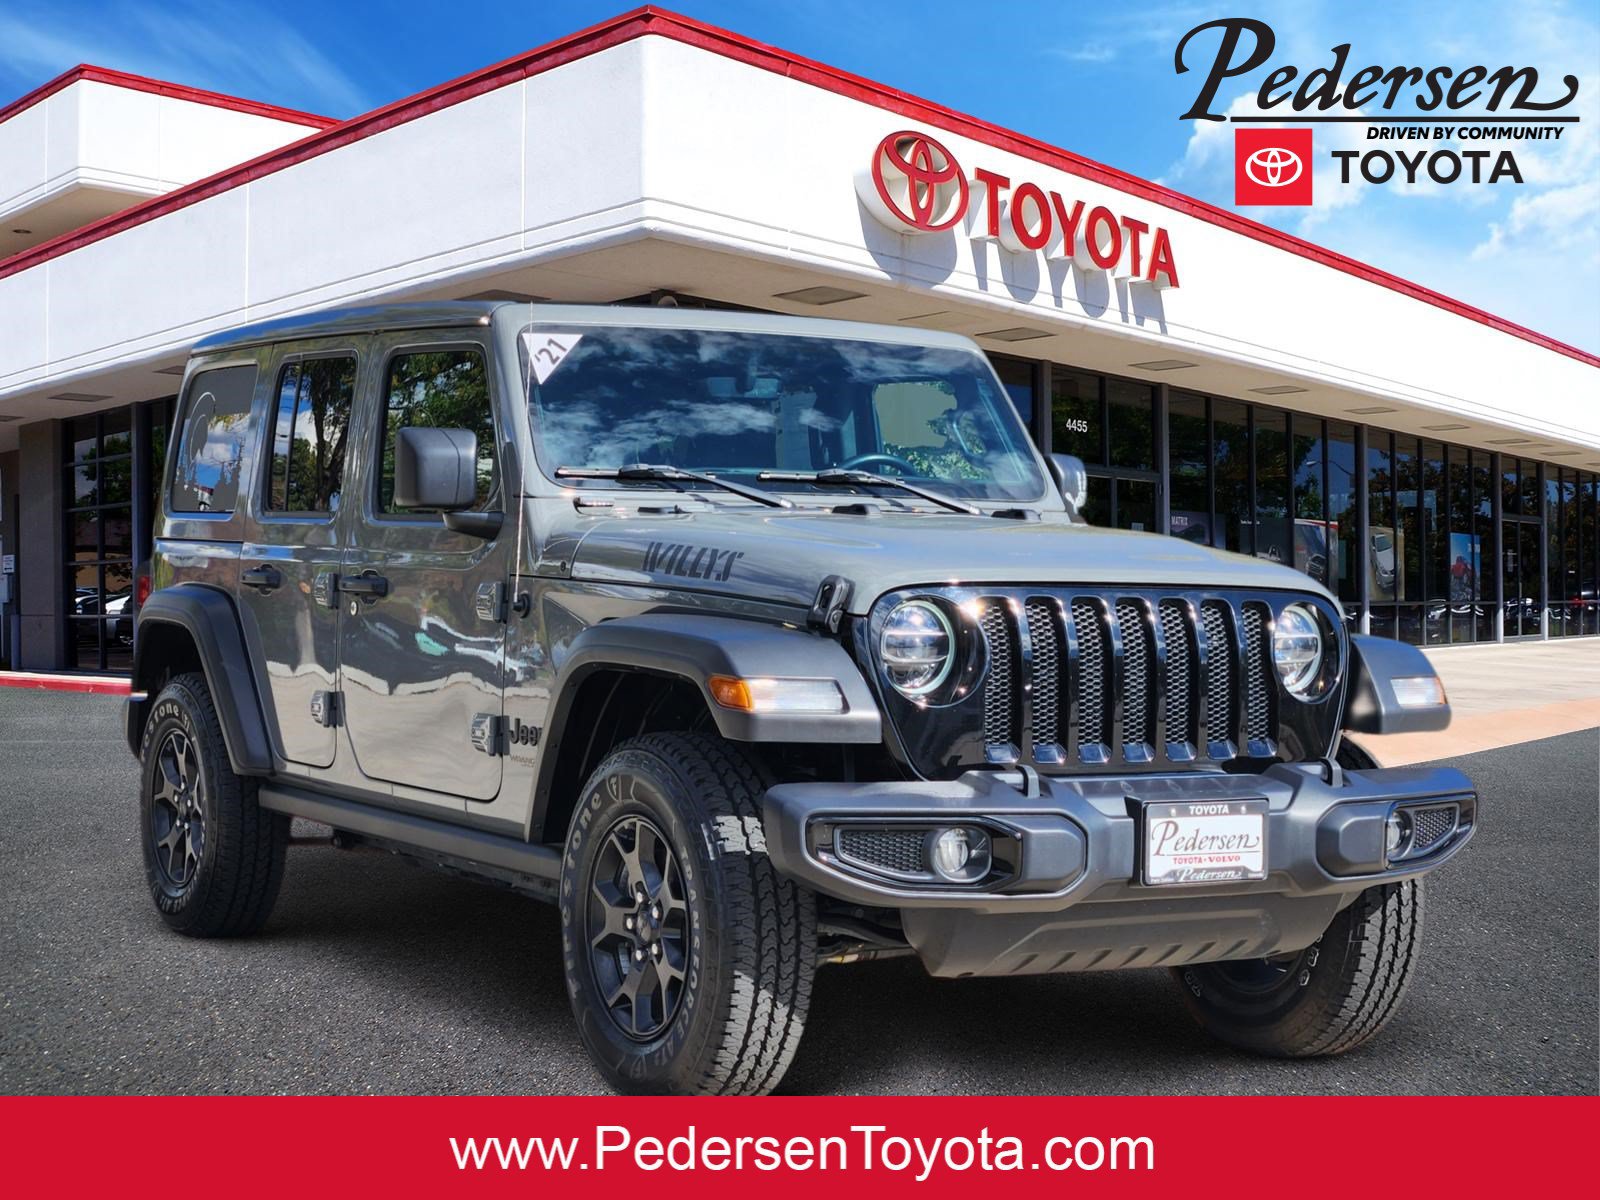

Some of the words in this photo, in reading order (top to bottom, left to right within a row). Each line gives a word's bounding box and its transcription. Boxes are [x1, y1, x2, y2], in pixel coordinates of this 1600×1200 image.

[975, 167, 1180, 289] TOYOTA
[1065, 418, 1088, 433] 4455
[1171, 515, 1188, 527] MATRIX
[1189, 804, 1229, 816] TOYOTA
[1151, 820, 1260, 857] Pedersen
[1173, 857, 1203, 865] TOYOTA
[1208, 855, 1241, 863] VOLVO
